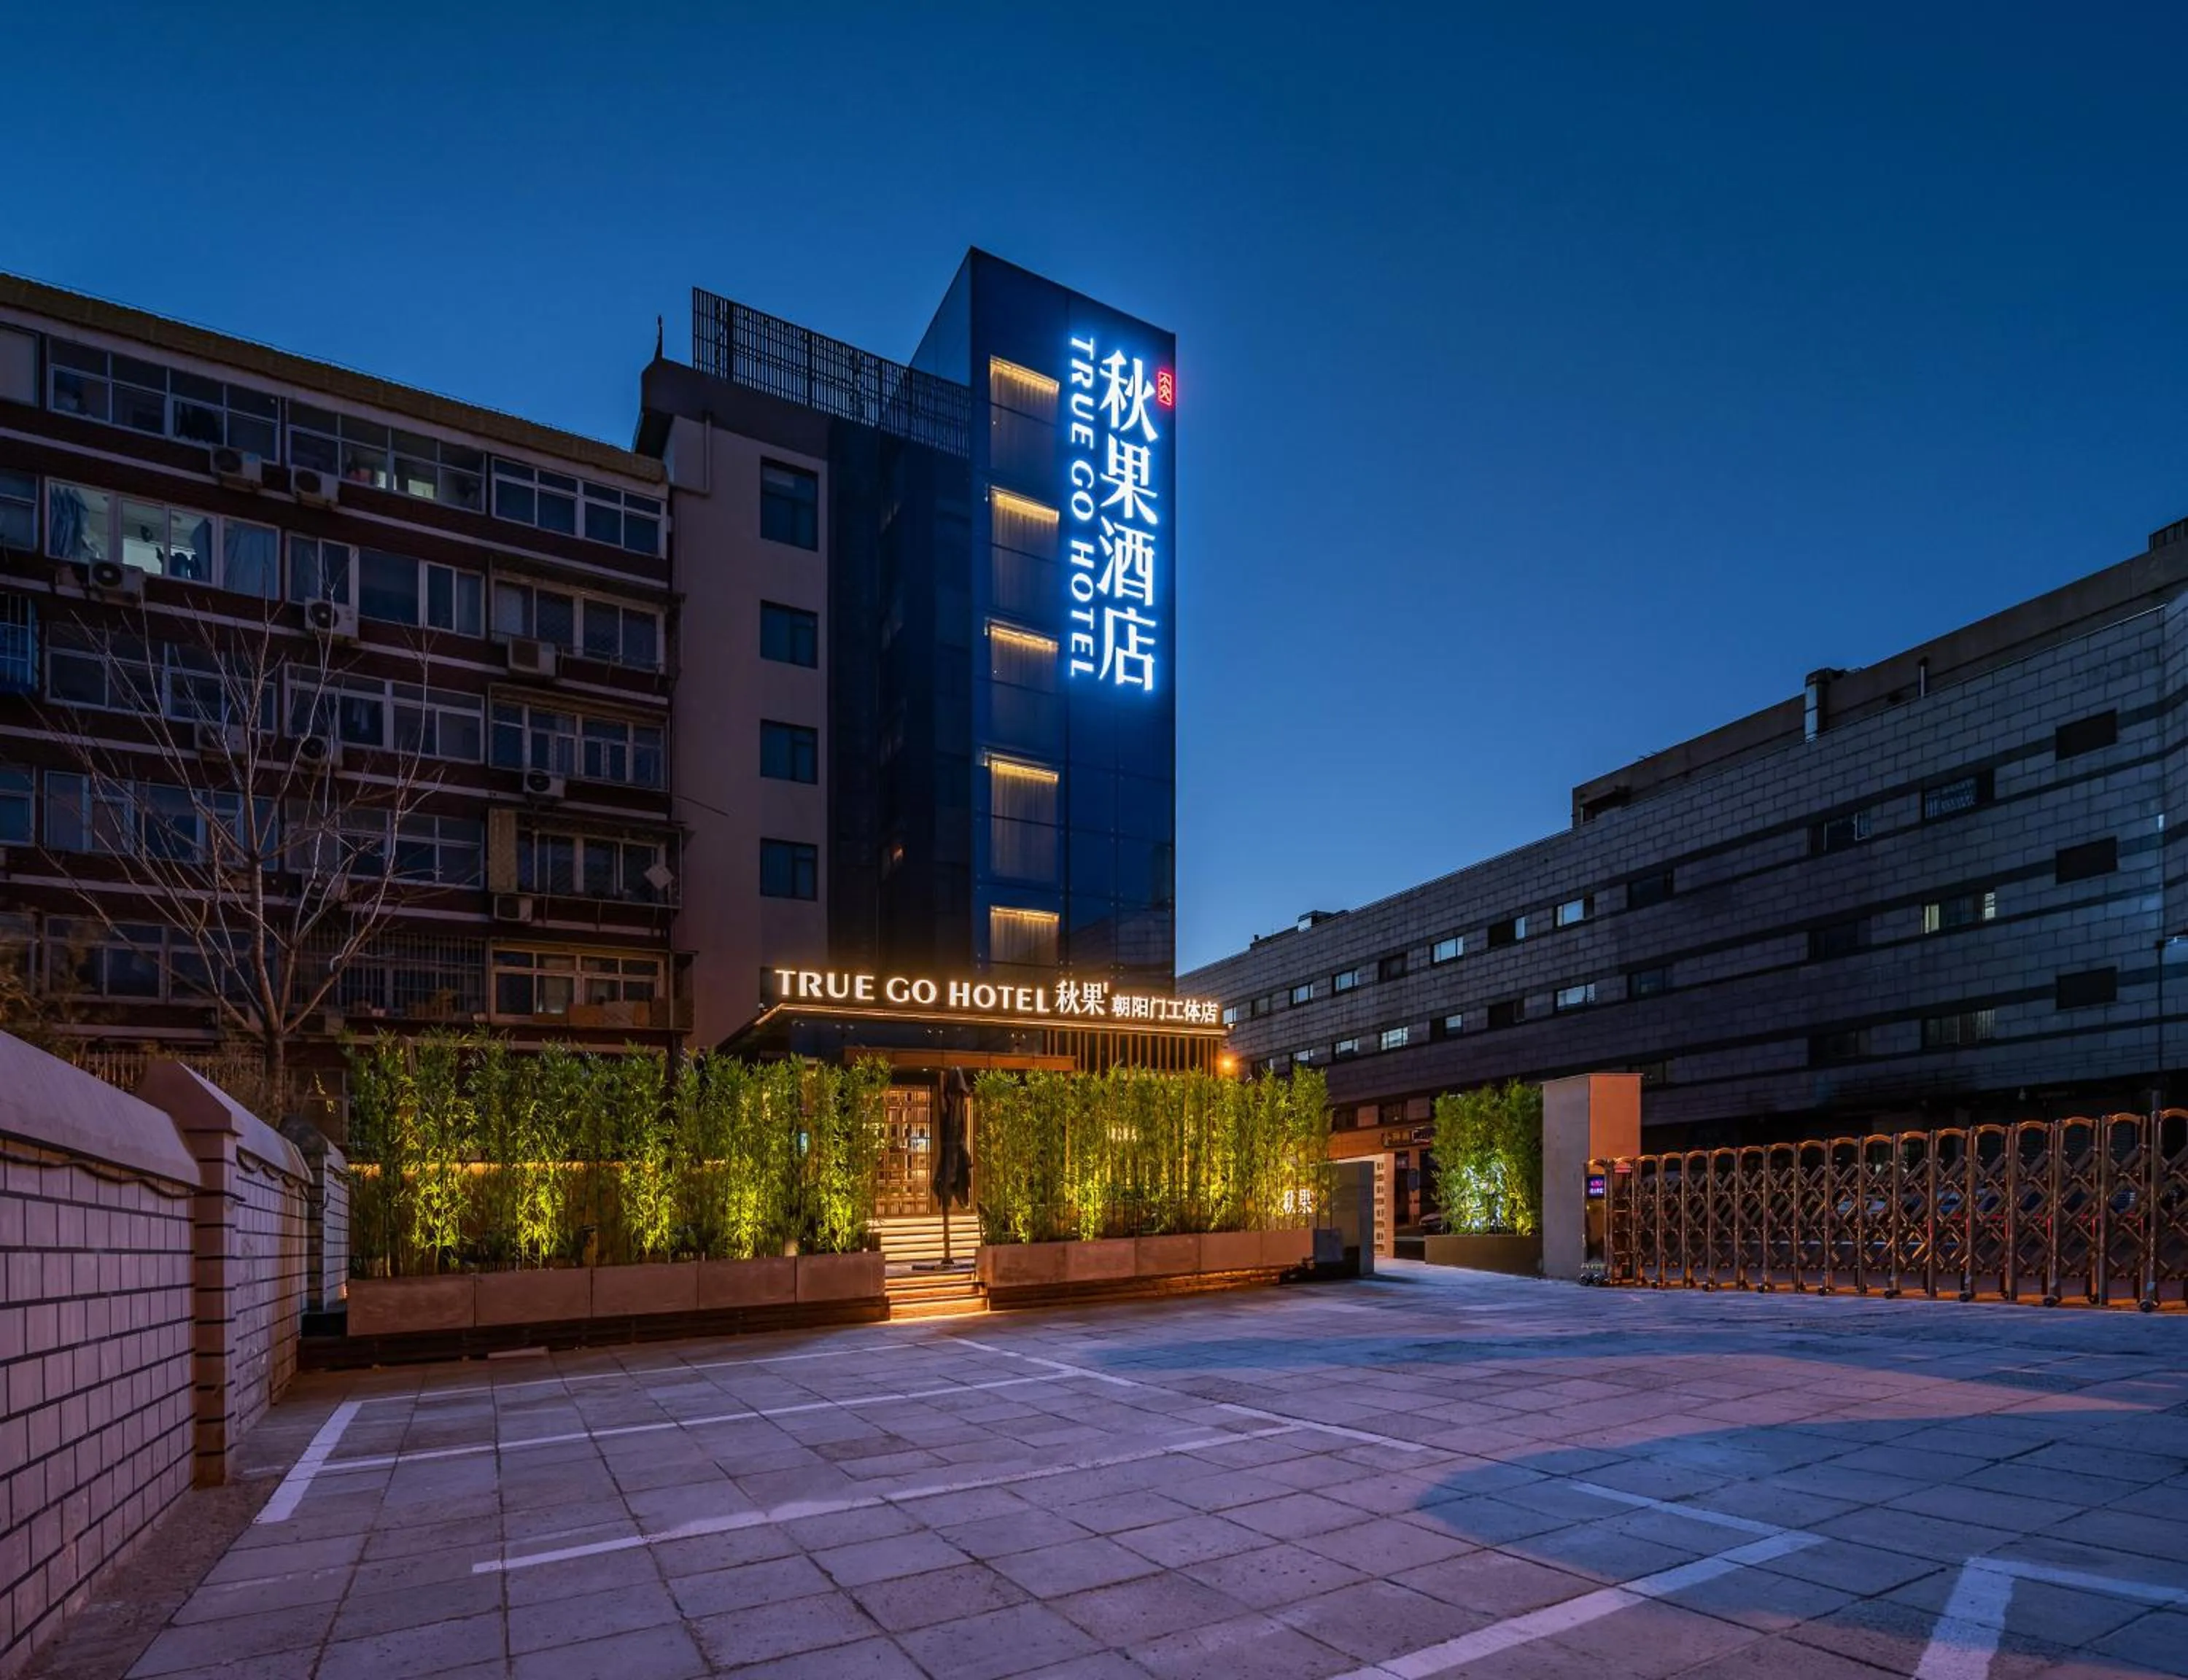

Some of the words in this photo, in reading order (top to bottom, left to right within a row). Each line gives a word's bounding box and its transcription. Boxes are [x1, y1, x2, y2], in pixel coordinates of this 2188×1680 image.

[1071, 338, 1094, 448] TRUE
[1071, 459, 1094, 521] GO
[1096, 349, 1158, 691] 秋果酒店
[1071, 540, 1094, 677] HOTEL
[775, 970, 874, 999] TRUE
[886, 977, 937, 1004] GO
[949, 981, 1050, 1013] HOTEL
[1055, 980, 1106, 1016] 秋果
[1111, 994, 1219, 1023] 朝阳门工体店
